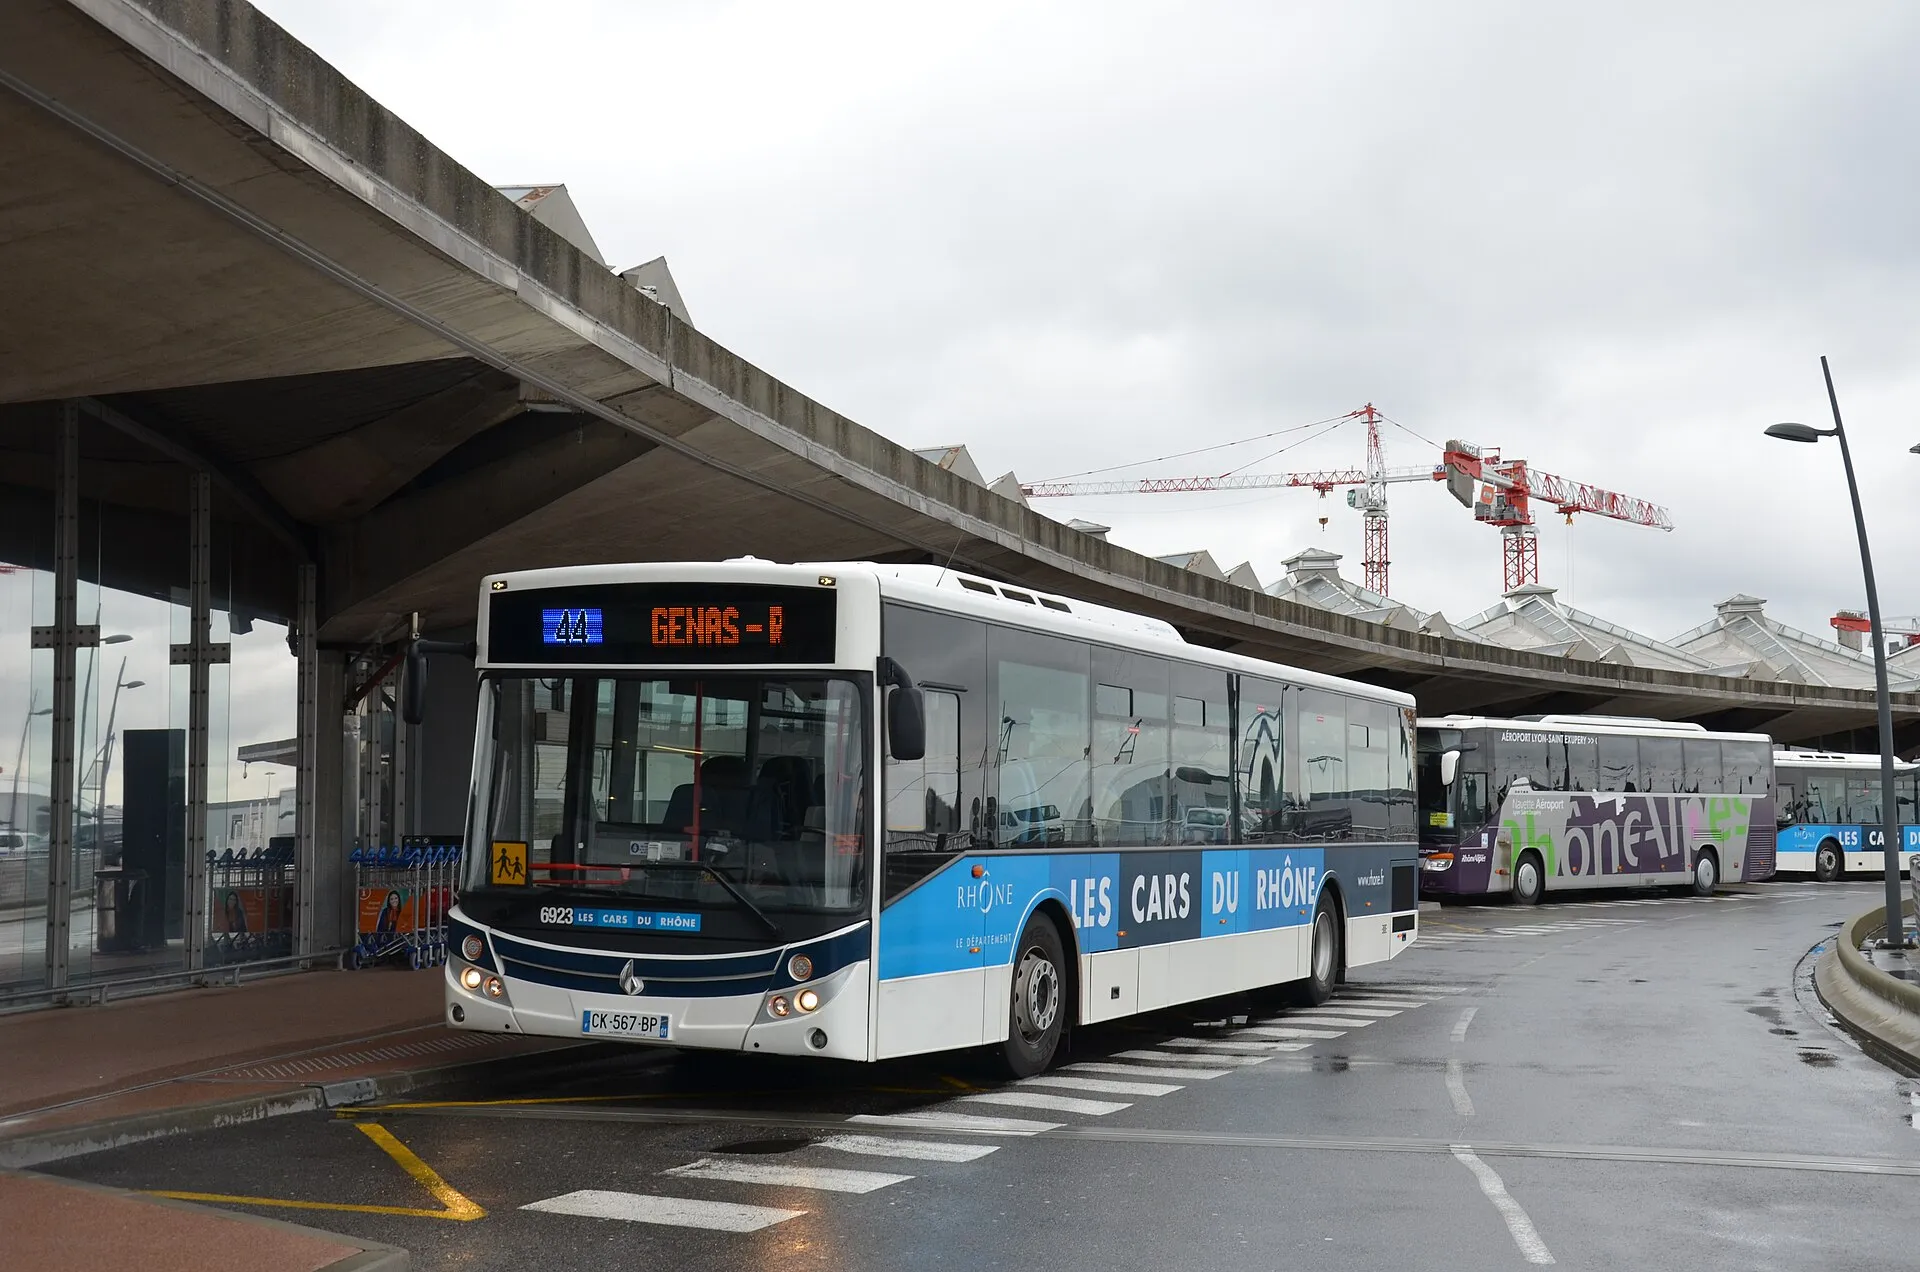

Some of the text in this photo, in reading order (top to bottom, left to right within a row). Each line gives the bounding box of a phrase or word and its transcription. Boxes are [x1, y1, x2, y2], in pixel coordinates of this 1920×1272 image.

[554, 608, 591, 647] 44
[651, 607, 739, 644] GENAS
[1501, 730, 1530, 743] AÉROPORT
[1535, 798, 1564, 811] Aéroport
[1838, 831, 1858, 846] LES
[1868, 831, 1900, 846] CA
[957, 869, 1013, 914] RHÔNE
[1070, 854, 1316, 929] LES CARS DU RHÔNE
[540, 907, 573, 924] 6923
[578, 913, 696, 928] LES CARS DU RHÔNE
[956, 933, 1012, 949] LE DÉPARTEMENT
[592, 1013, 658, 1032] CK-567-BP
